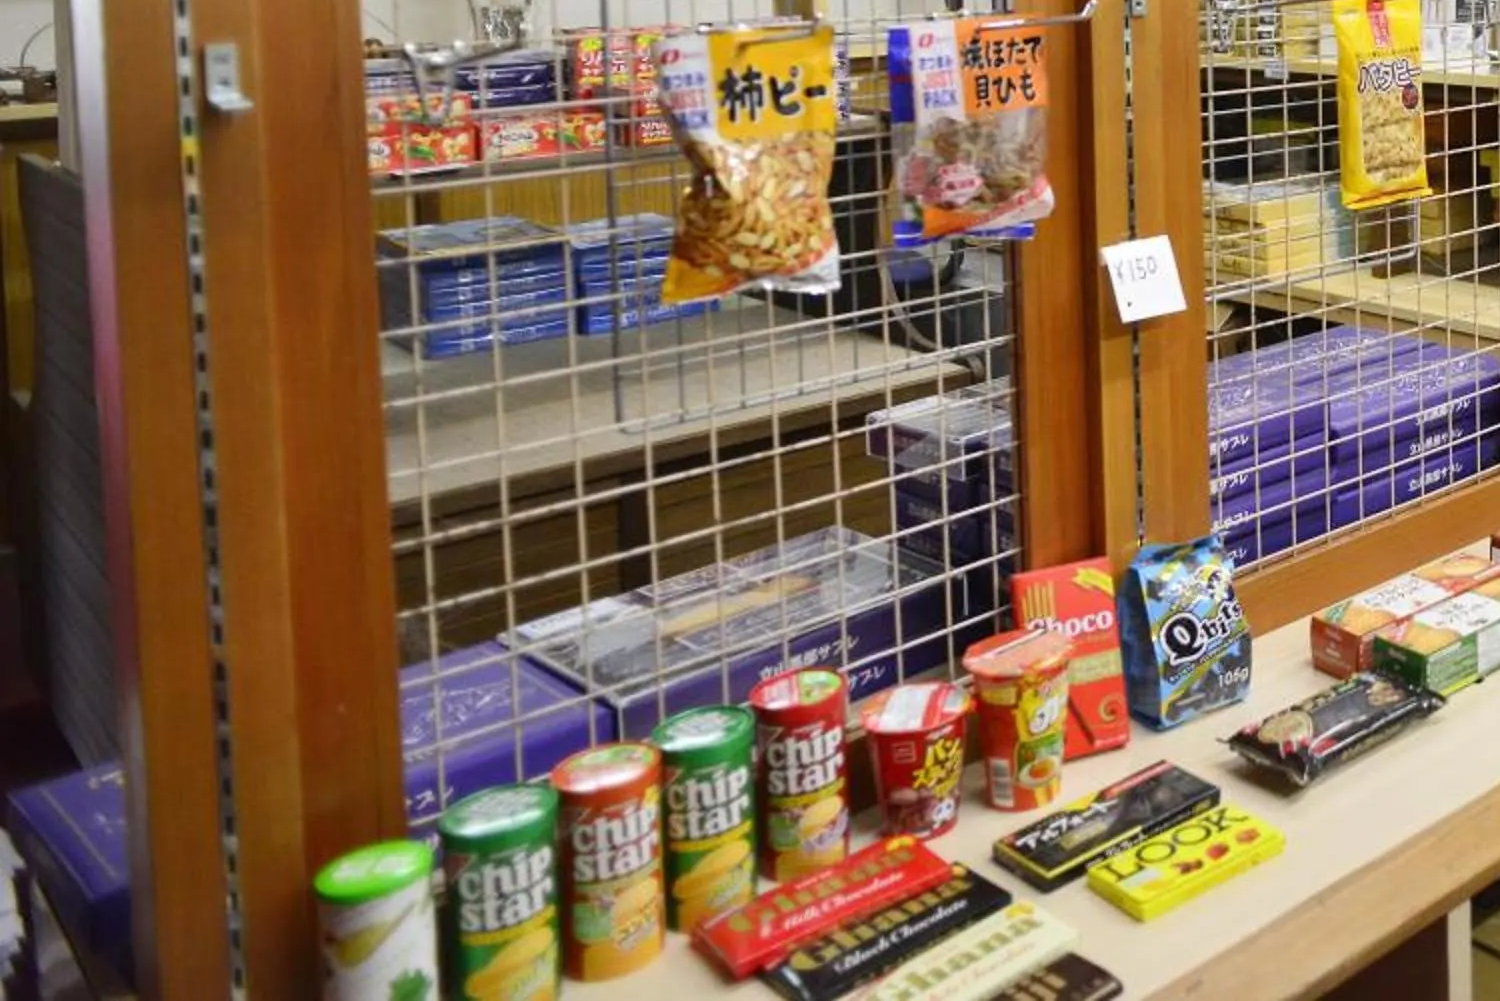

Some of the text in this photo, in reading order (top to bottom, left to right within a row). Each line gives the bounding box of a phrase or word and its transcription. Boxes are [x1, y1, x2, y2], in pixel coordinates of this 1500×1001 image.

[961, 35, 1042, 70] 焼ほたて
[719, 65, 828, 123] 柿ピー
[975, 70, 1036, 108] 貝ひも
[1113, 256, 1158, 284] ¥150
[1218, 667, 1249, 689] 105g
[767, 726, 843, 768] chip
[667, 767, 748, 810] chip
[768, 752, 845, 796] star
[572, 800, 660, 853] chip
[668, 794, 750, 839] star
[573, 832, 660, 884] star
[1100, 807, 1250, 883] LOOK
[458, 845, 554, 899] chip
[460, 876, 556, 933] star
